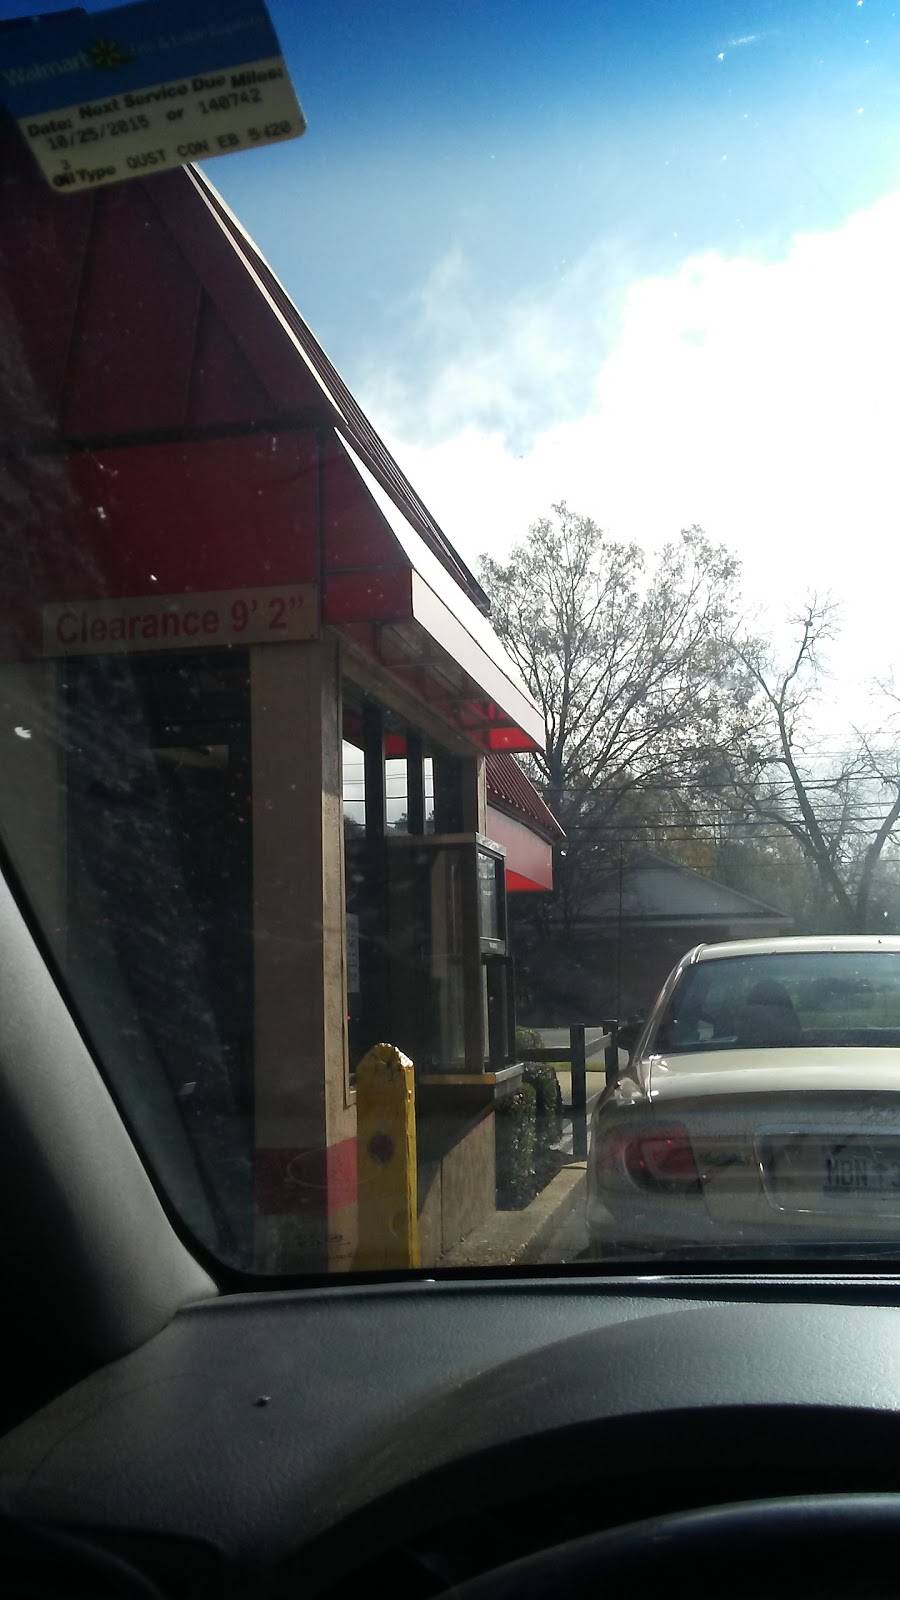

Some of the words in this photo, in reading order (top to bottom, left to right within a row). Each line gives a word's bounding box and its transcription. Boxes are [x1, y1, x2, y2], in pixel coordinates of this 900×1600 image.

[2, 51, 89, 88] Walmart
[79, 98, 120, 119] Next
[124, 84, 188, 108] Service
[192, 75, 225, 91] Due
[28, 119, 72, 137] Date:
[48, 114, 149, 149] 10/25/2015
[166, 107, 184, 121] or
[77, 166, 116, 183] Type
[56, 609, 218, 645] Clearance
[231, 599, 257, 633] 9'
[268, 595, 304, 630] 2"
